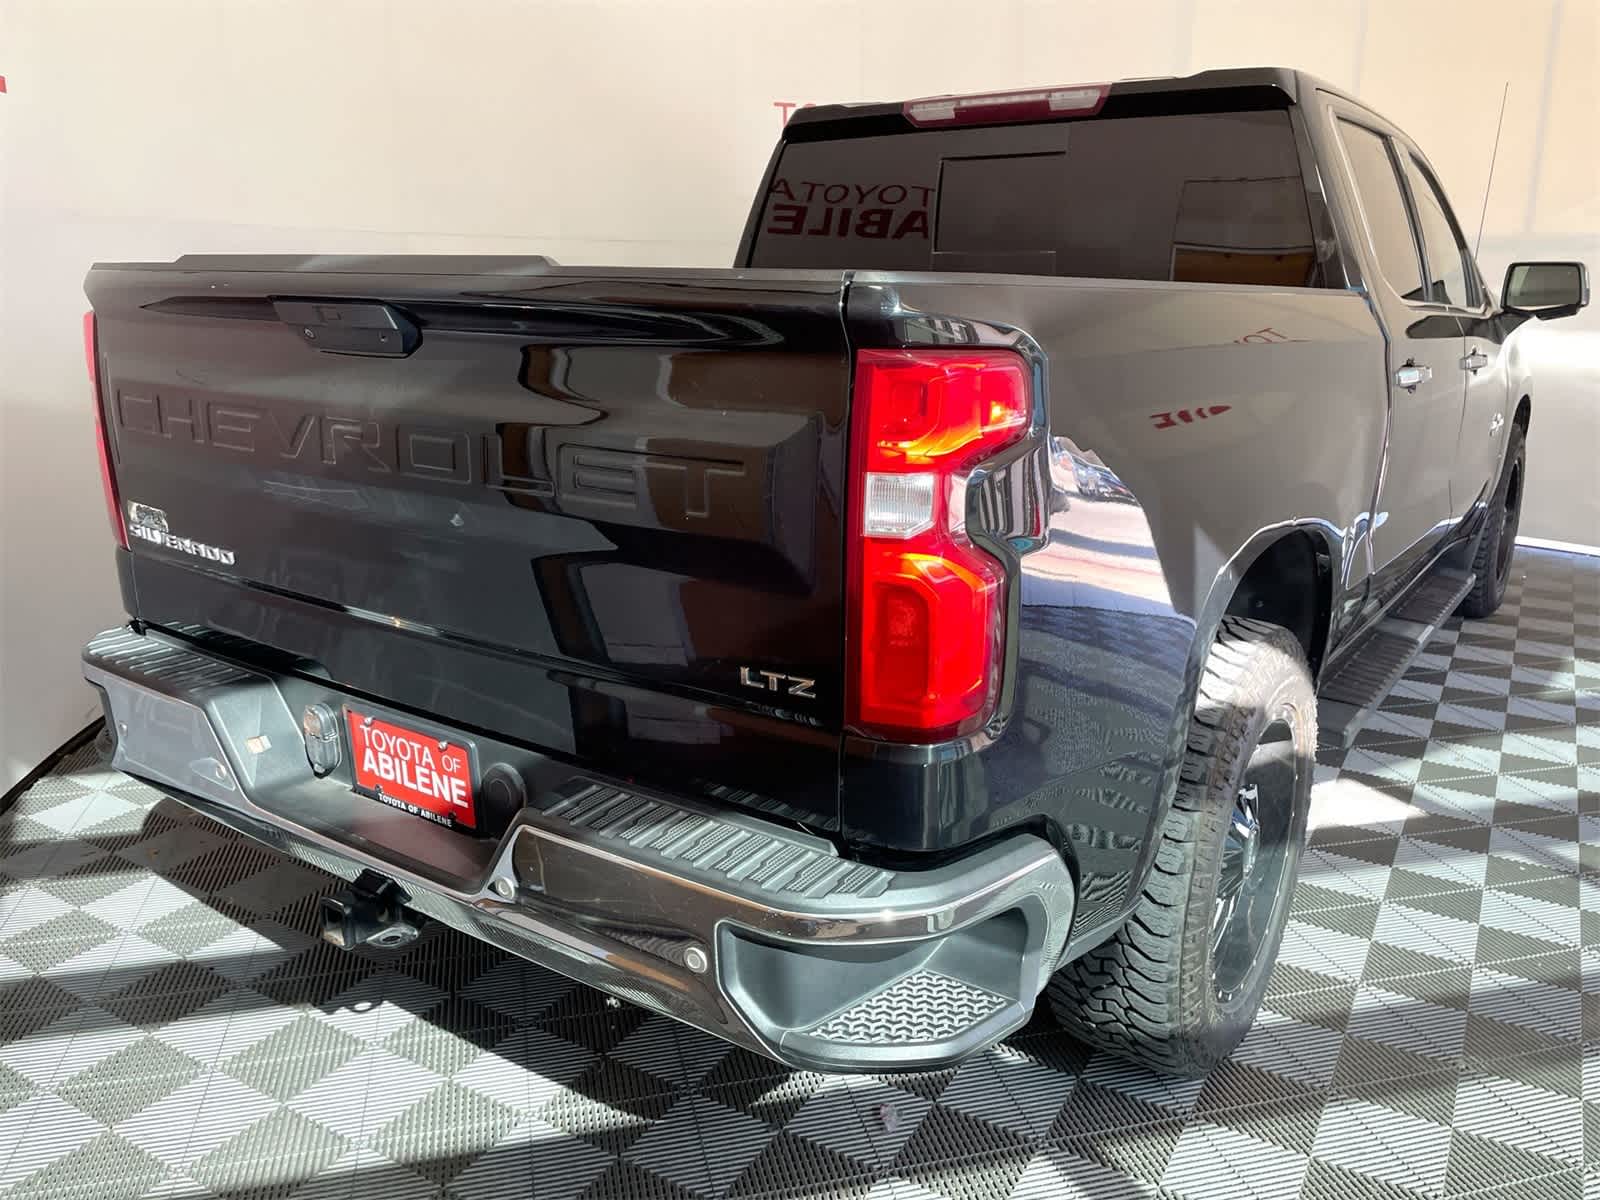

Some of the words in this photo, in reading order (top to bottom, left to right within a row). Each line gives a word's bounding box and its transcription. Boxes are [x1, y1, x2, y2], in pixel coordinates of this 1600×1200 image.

[117, 389, 746, 519] CHEVROLET
[129, 523, 235, 566] SILVERADO
[740, 666, 817, 699] LTZ
[360, 724, 436, 769] TOYOTA
[441, 755, 462, 773] OF
[364, 748, 469, 808] ABILENE
[379, 794, 407, 810] TOYOTA
[408, 804, 418, 814] OF
[420, 808, 453, 827] ABILENE
